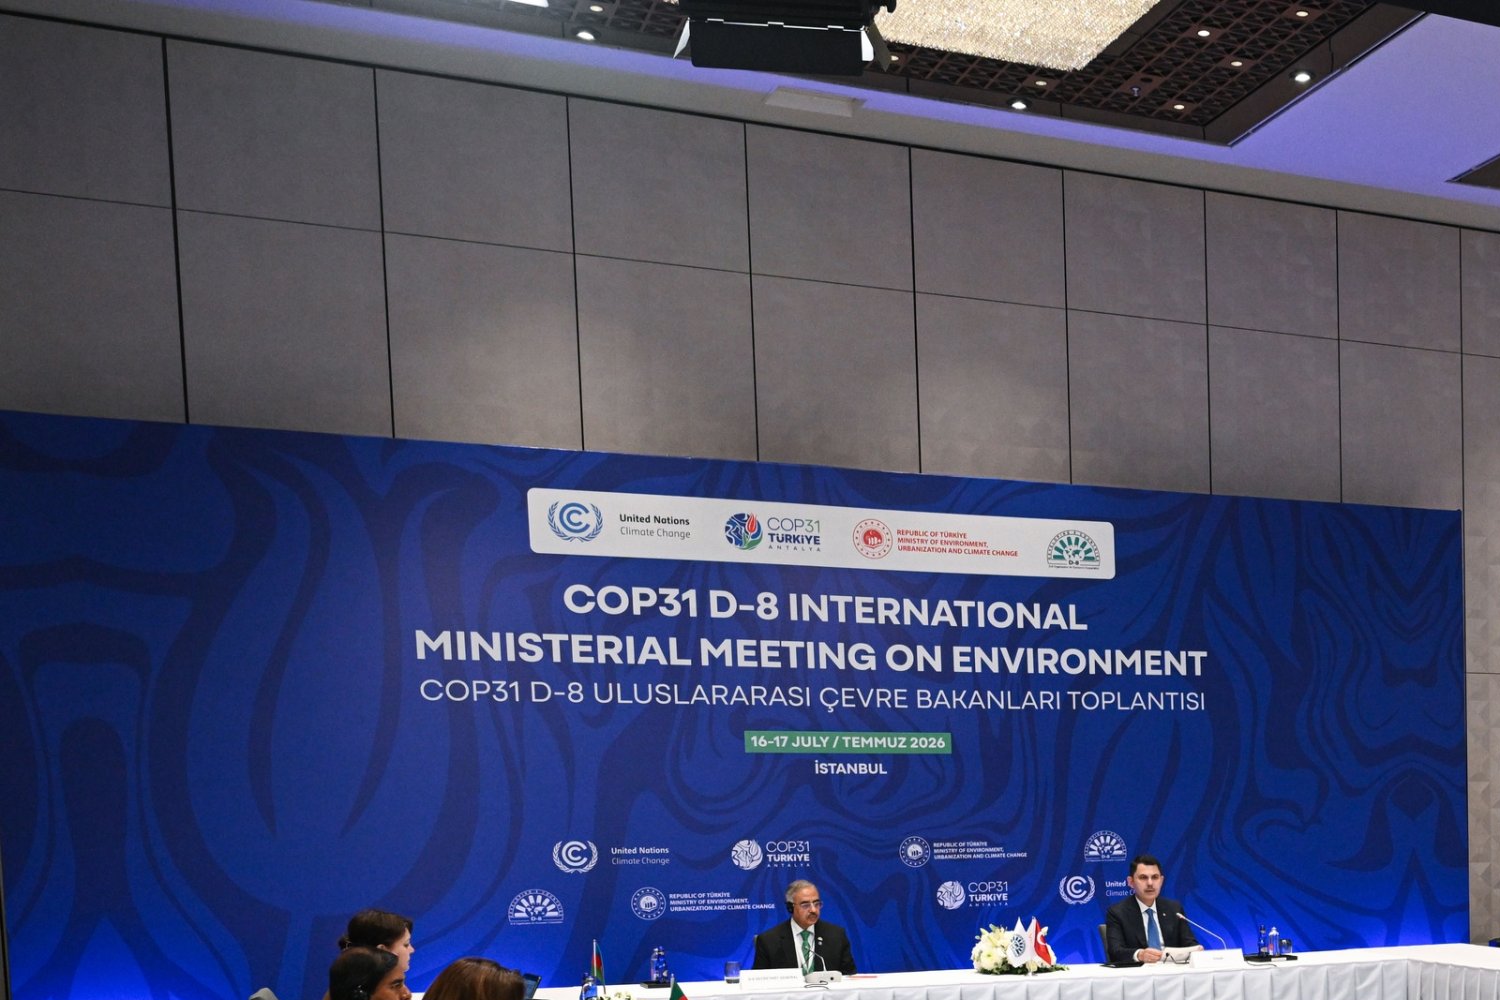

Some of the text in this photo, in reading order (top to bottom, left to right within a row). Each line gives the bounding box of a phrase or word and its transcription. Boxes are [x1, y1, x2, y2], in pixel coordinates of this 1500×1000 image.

[619, 513, 690, 526] United Nations
[767, 517, 821, 533] COP31
[620, 526, 691, 539] Climate Change
[897, 529, 929, 538] REPUBLIC
[897, 537, 989, 548] MINISTRY OF ENVIRONMENT,
[897, 545, 1019, 557] URBANIZATION AND CLIMATE CHANGE
[563, 583, 1088, 631] COP31 D-8 INTERNATIONAL
[415, 629, 1208, 677] MINISTERIAL MEETING ON ENVIRONMENT
[419, 679, 1205, 713] COP31 D-8 ULUSLARARASI ÇEVRE BAKANLARI TOPLANTISI
[750, 734, 946, 750] 16-17 JULY / TEMMUZ 2026
[814, 759, 888, 775] İSTANBUL
[611, 846, 670, 855] United Nations
[766, 840, 811, 852] COP31
[611, 855, 670, 866] Climate Change
[968, 881, 1009, 893] COP31
[1105, 888, 1129, 897] Climate
